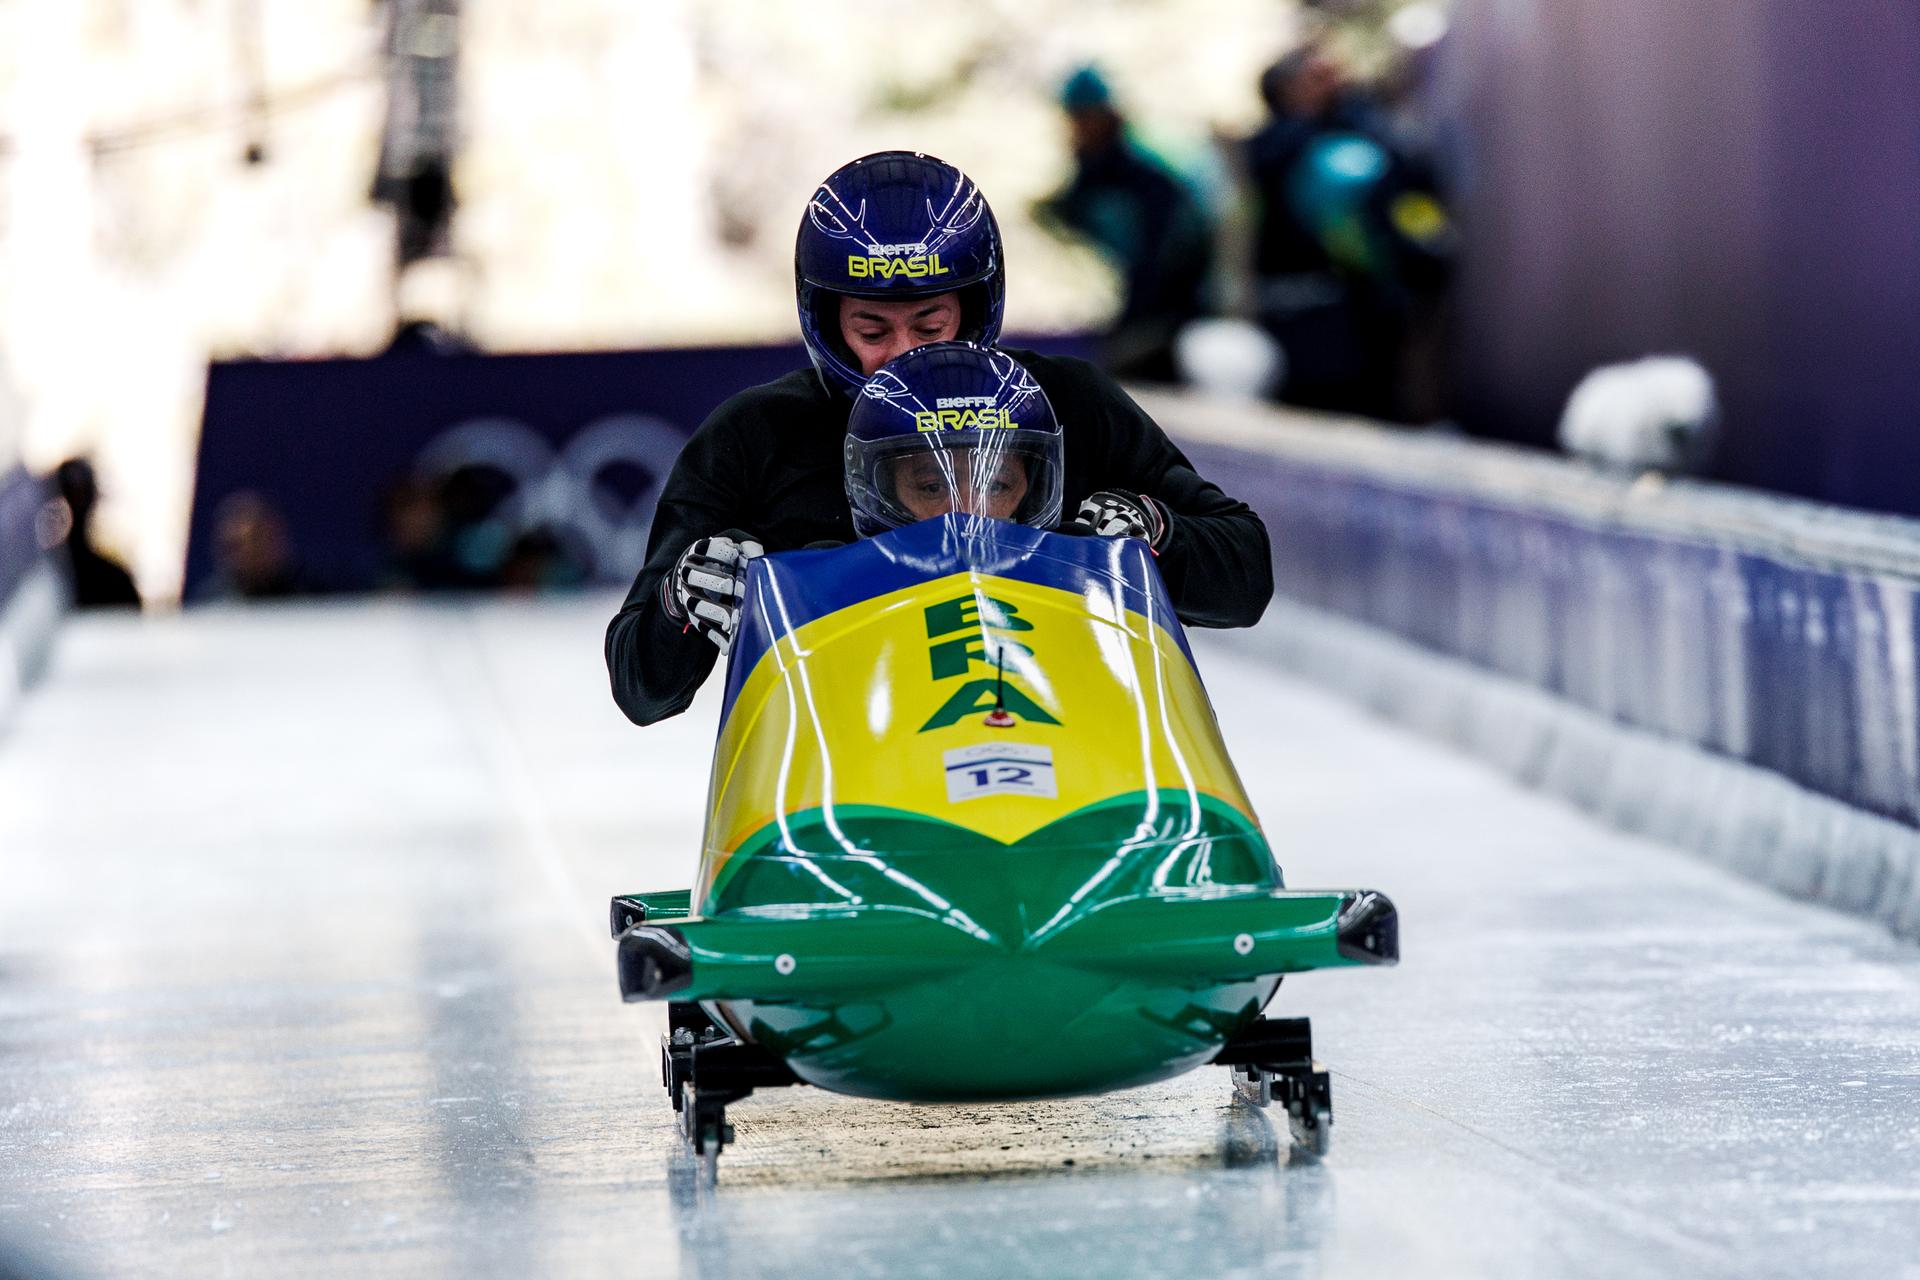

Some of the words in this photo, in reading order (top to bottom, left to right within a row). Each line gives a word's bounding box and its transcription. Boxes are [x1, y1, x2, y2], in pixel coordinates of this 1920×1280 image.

[848, 254, 949, 278] BRASIL
[916, 409, 1018, 432] BRASIL
[917, 593, 1064, 733] BRA
[968, 767, 1034, 786] 12
